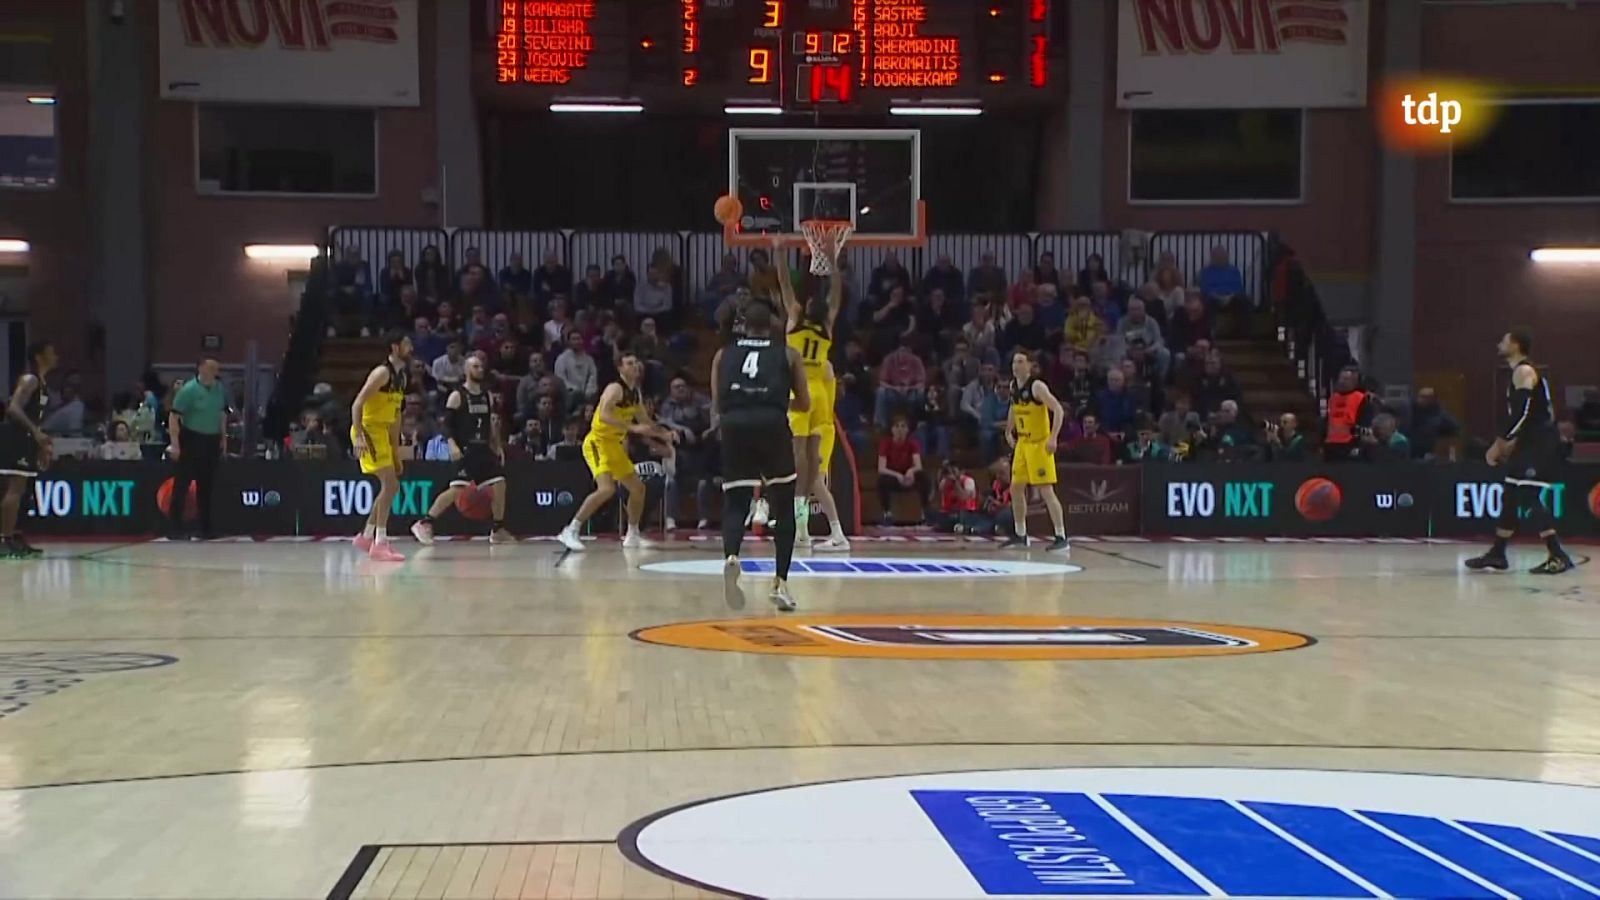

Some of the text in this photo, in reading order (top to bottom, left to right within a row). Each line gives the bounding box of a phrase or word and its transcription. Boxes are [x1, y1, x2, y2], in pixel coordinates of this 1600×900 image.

[874, 6, 926, 21] SASTRE
[524, 19, 584, 33] BILIGHA
[874, 23, 915, 37] BADJI
[497, 34, 516, 49] 20
[524, 36, 593, 50] SEVERINI
[874, 39, 957, 54] SHERMADINI
[498, 51, 585, 67] 23 JOSOVIC
[750, 49, 768, 82] 9
[874, 56, 957, 70] ABROMAITIS
[498, 68, 694, 85] 34 WEEMS 2
[811, 64, 850, 102] 14
[874, 72, 957, 87] DOORNEKAMP
[803, 337, 820, 361] 11
[740, 350, 760, 379] 4
[27, 480, 135, 516] VO NXT
[323, 480, 373, 515] EVO
[1168, 482, 1273, 517] EVO NXT
[1456, 483, 1503, 517] EVO
[1069, 503, 1129, 512] BERTRAM
[965, 796, 1135, 885] GRUPPO ASTM
